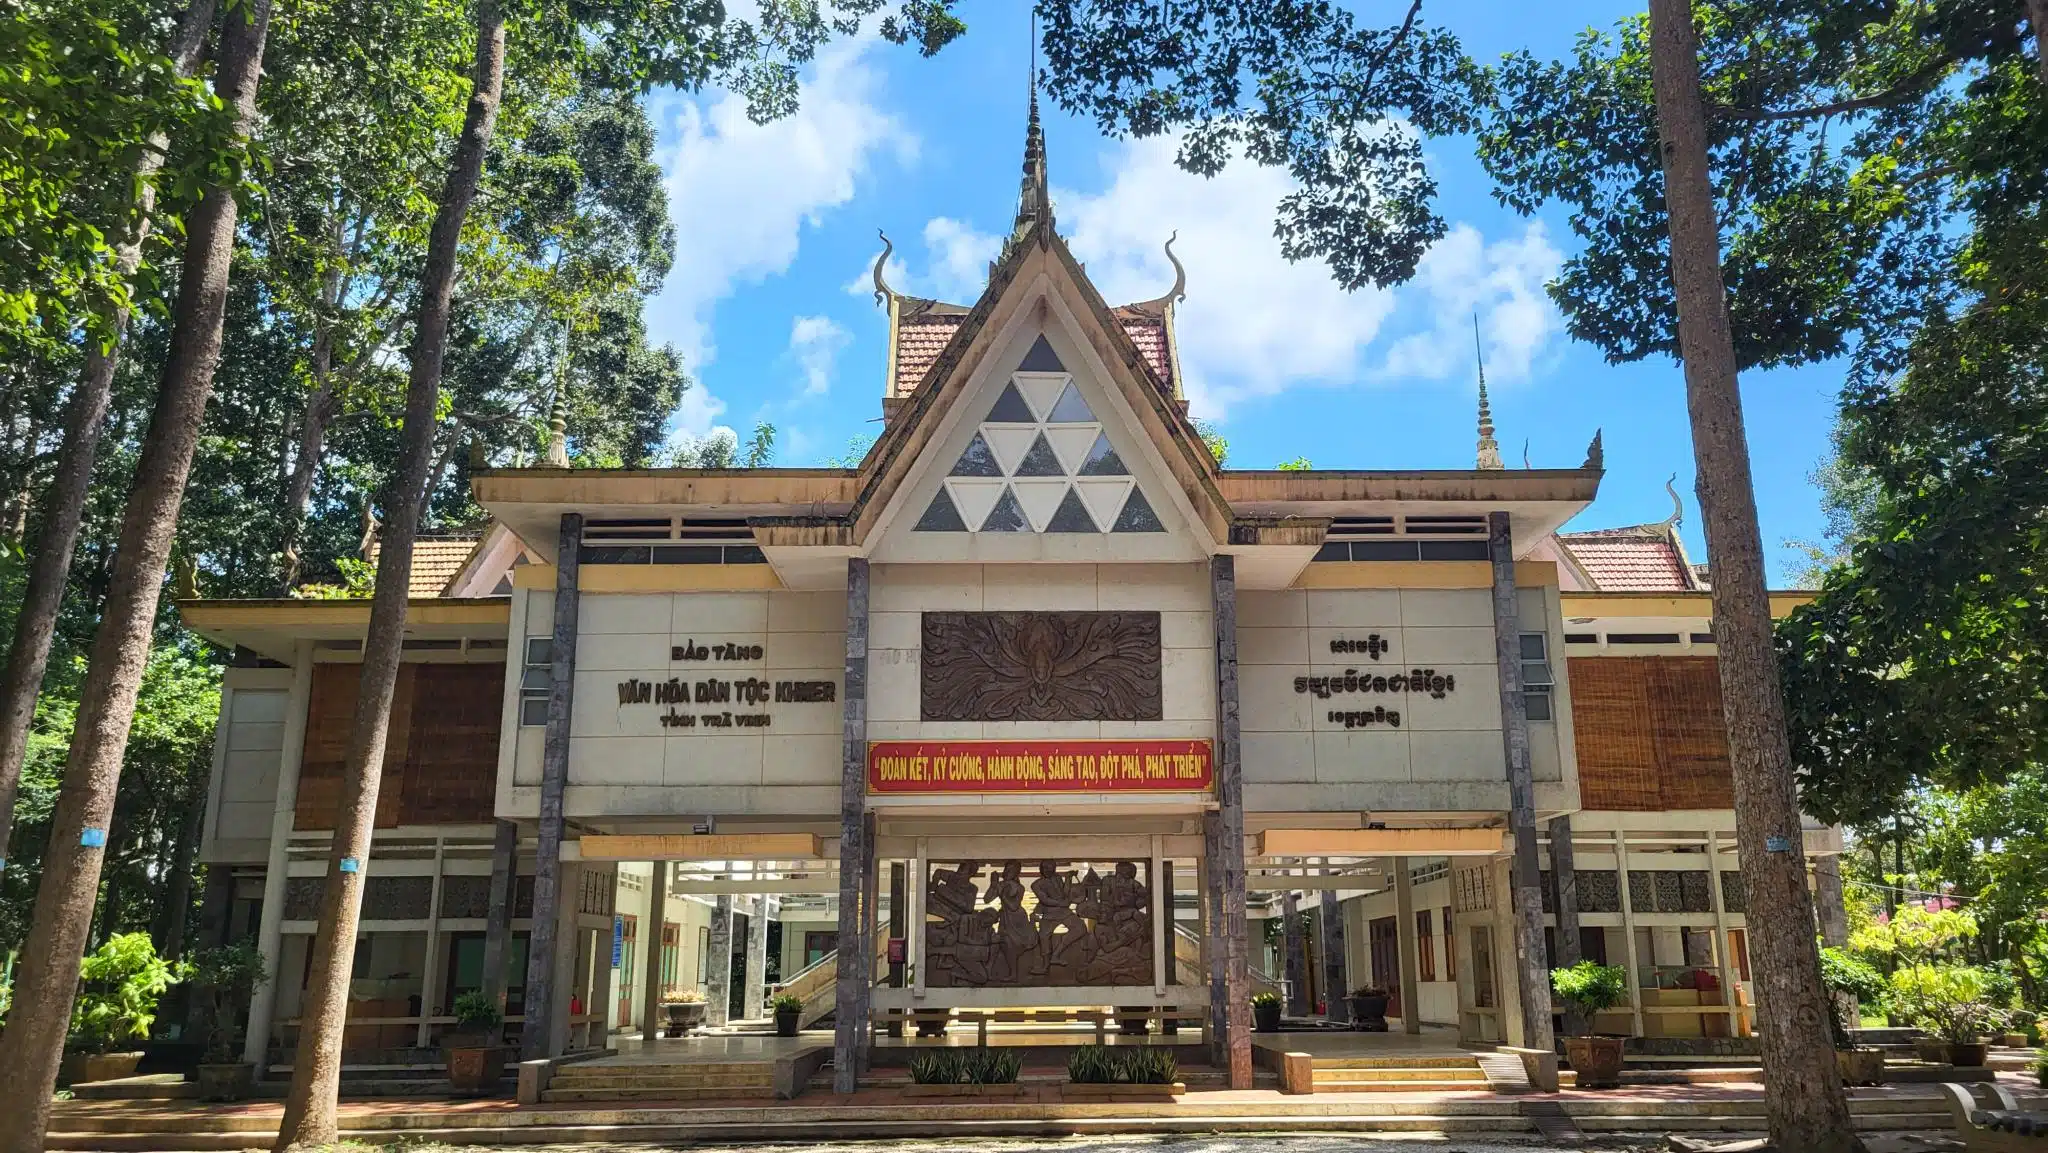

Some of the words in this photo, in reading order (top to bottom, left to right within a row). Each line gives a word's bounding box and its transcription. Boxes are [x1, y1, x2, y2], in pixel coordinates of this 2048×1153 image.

[672, 639, 709, 661] BẢO
[618, 679, 652, 704] VĂN
[655, 678, 690, 704] HÓA
[695, 678, 730, 703] DÂN
[734, 677, 770, 705] TỘC
[775, 681, 836, 703] KHMER
[660, 707, 695, 727] TỈNH
[701, 712, 732, 727] TRÀ
[735, 714, 770, 727] VINH
[909, 746, 931, 785] KẾT,
[933, 747, 947, 780] KỶ
[987, 748, 1014, 780] HÀNH
[1016, 749, 1046, 788] ĐỘNG,
[1048, 748, 1074, 780] SÁNG
[1077, 754, 1099, 787] TẠO,
[1100, 749, 1119, 787] ĐỘT
[1121, 747, 1144, 784] PHÁ,
[1145, 747, 1171, 779] PHÁT
